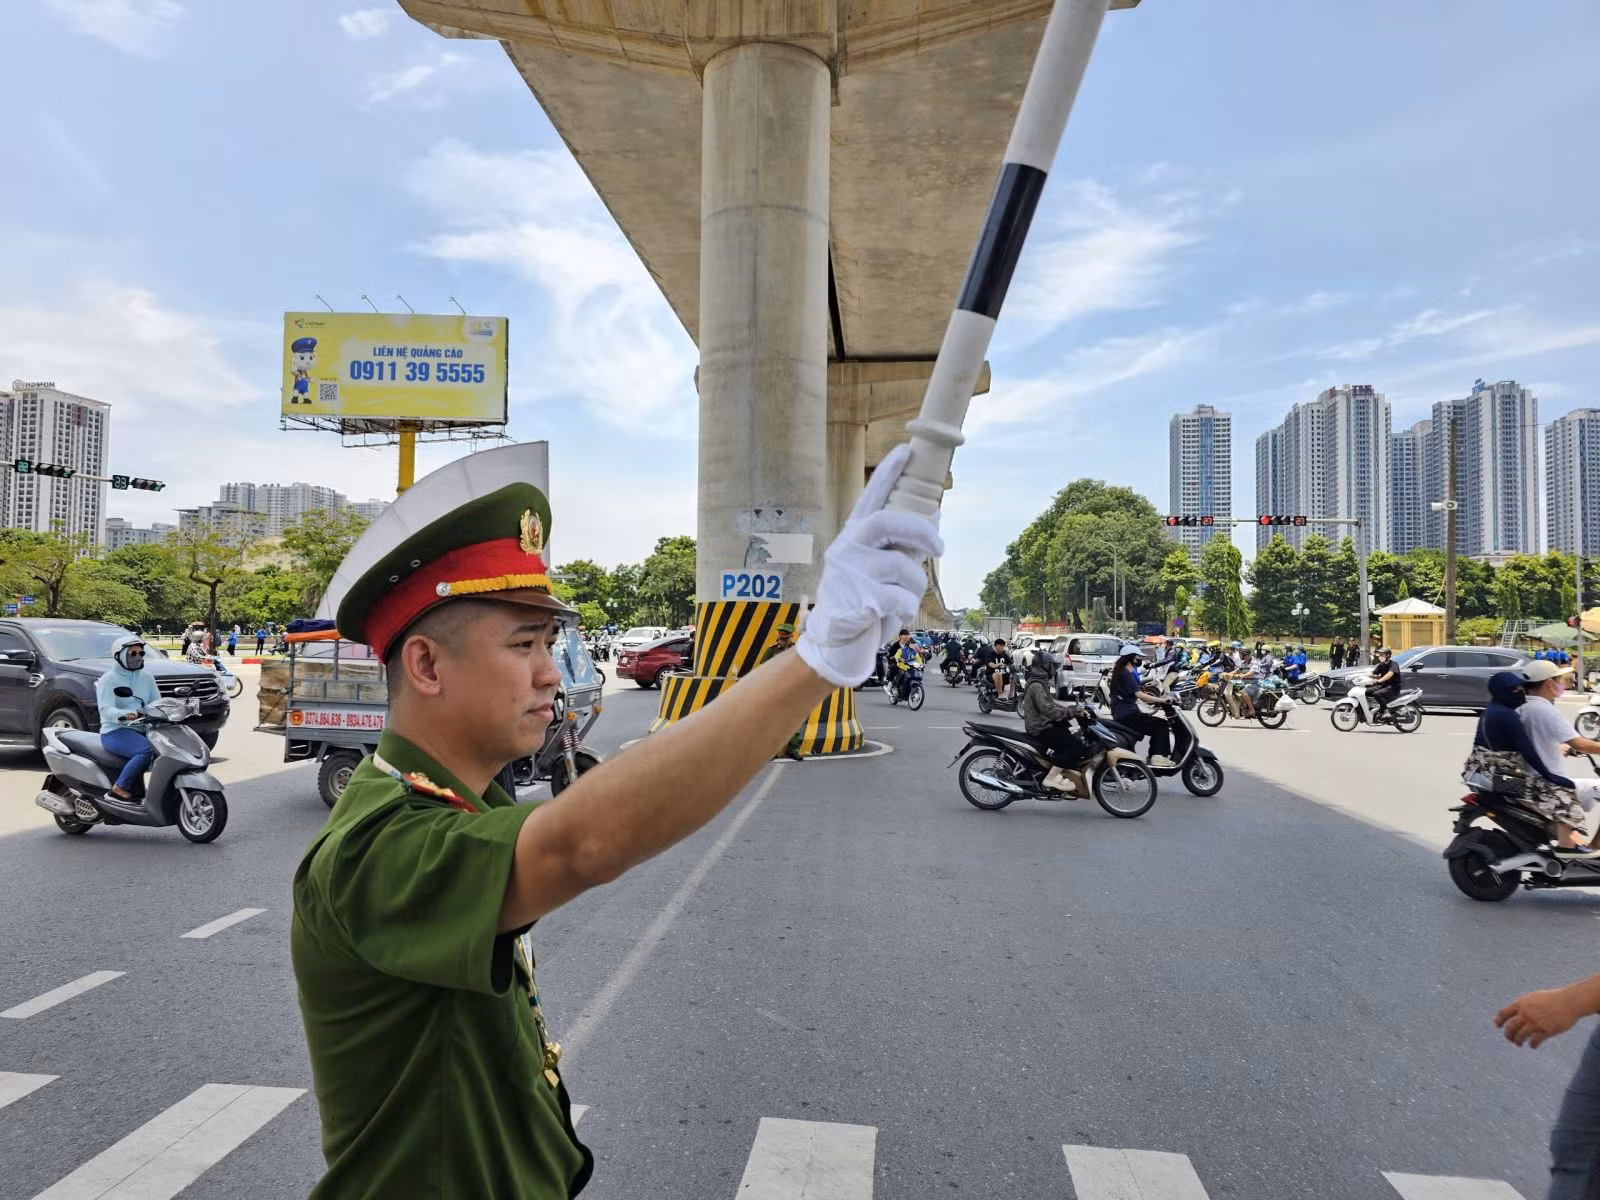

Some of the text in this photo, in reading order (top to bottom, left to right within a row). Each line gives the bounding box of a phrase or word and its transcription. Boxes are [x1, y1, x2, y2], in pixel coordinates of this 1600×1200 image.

[373, 345, 463, 359] LIÊN HỆ QUẢNG CÁO
[350, 360, 485, 383] 0911 39 5555
[723, 573, 781, 599] P202
